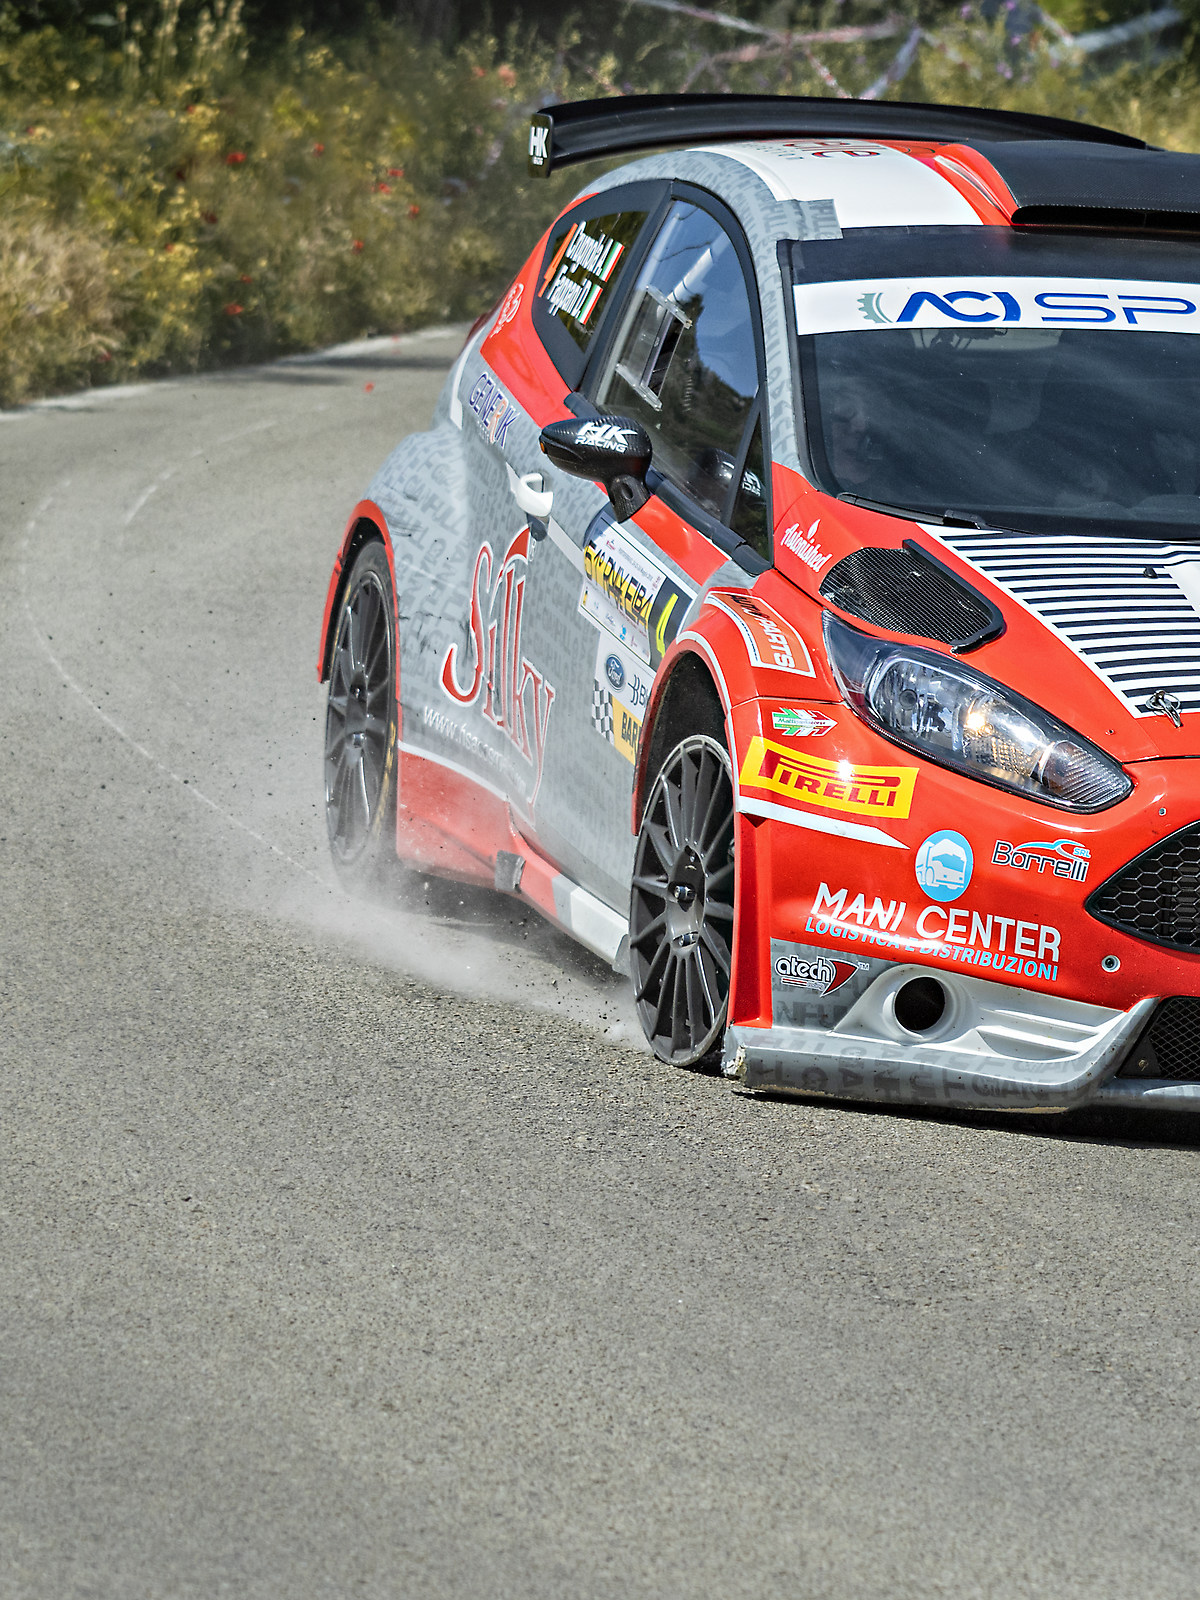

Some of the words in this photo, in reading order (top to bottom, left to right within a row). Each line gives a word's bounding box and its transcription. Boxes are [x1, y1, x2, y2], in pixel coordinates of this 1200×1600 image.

[528, 126, 549, 158] HK
[896, 291, 1021, 323] ACI
[469, 372, 521, 450] GENERIK
[574, 434, 629, 453] RACING
[576, 421, 639, 445] HK
[780, 522, 833, 573] Astonished
[439, 525, 556, 832] Silky
[607, 658, 624, 686] Ford
[758, 748, 901, 807] PIRELLI
[991, 840, 1090, 882] Borrelli
[1072, 846, 1092, 858] SRL
[810, 881, 907, 932] MANI
[915, 905, 1062, 963] CENTER
[804, 917, 900, 949] LOGISTICA
[919, 939, 1059, 982] DISTRIBUZIONI
[775, 955, 832, 983] atech
